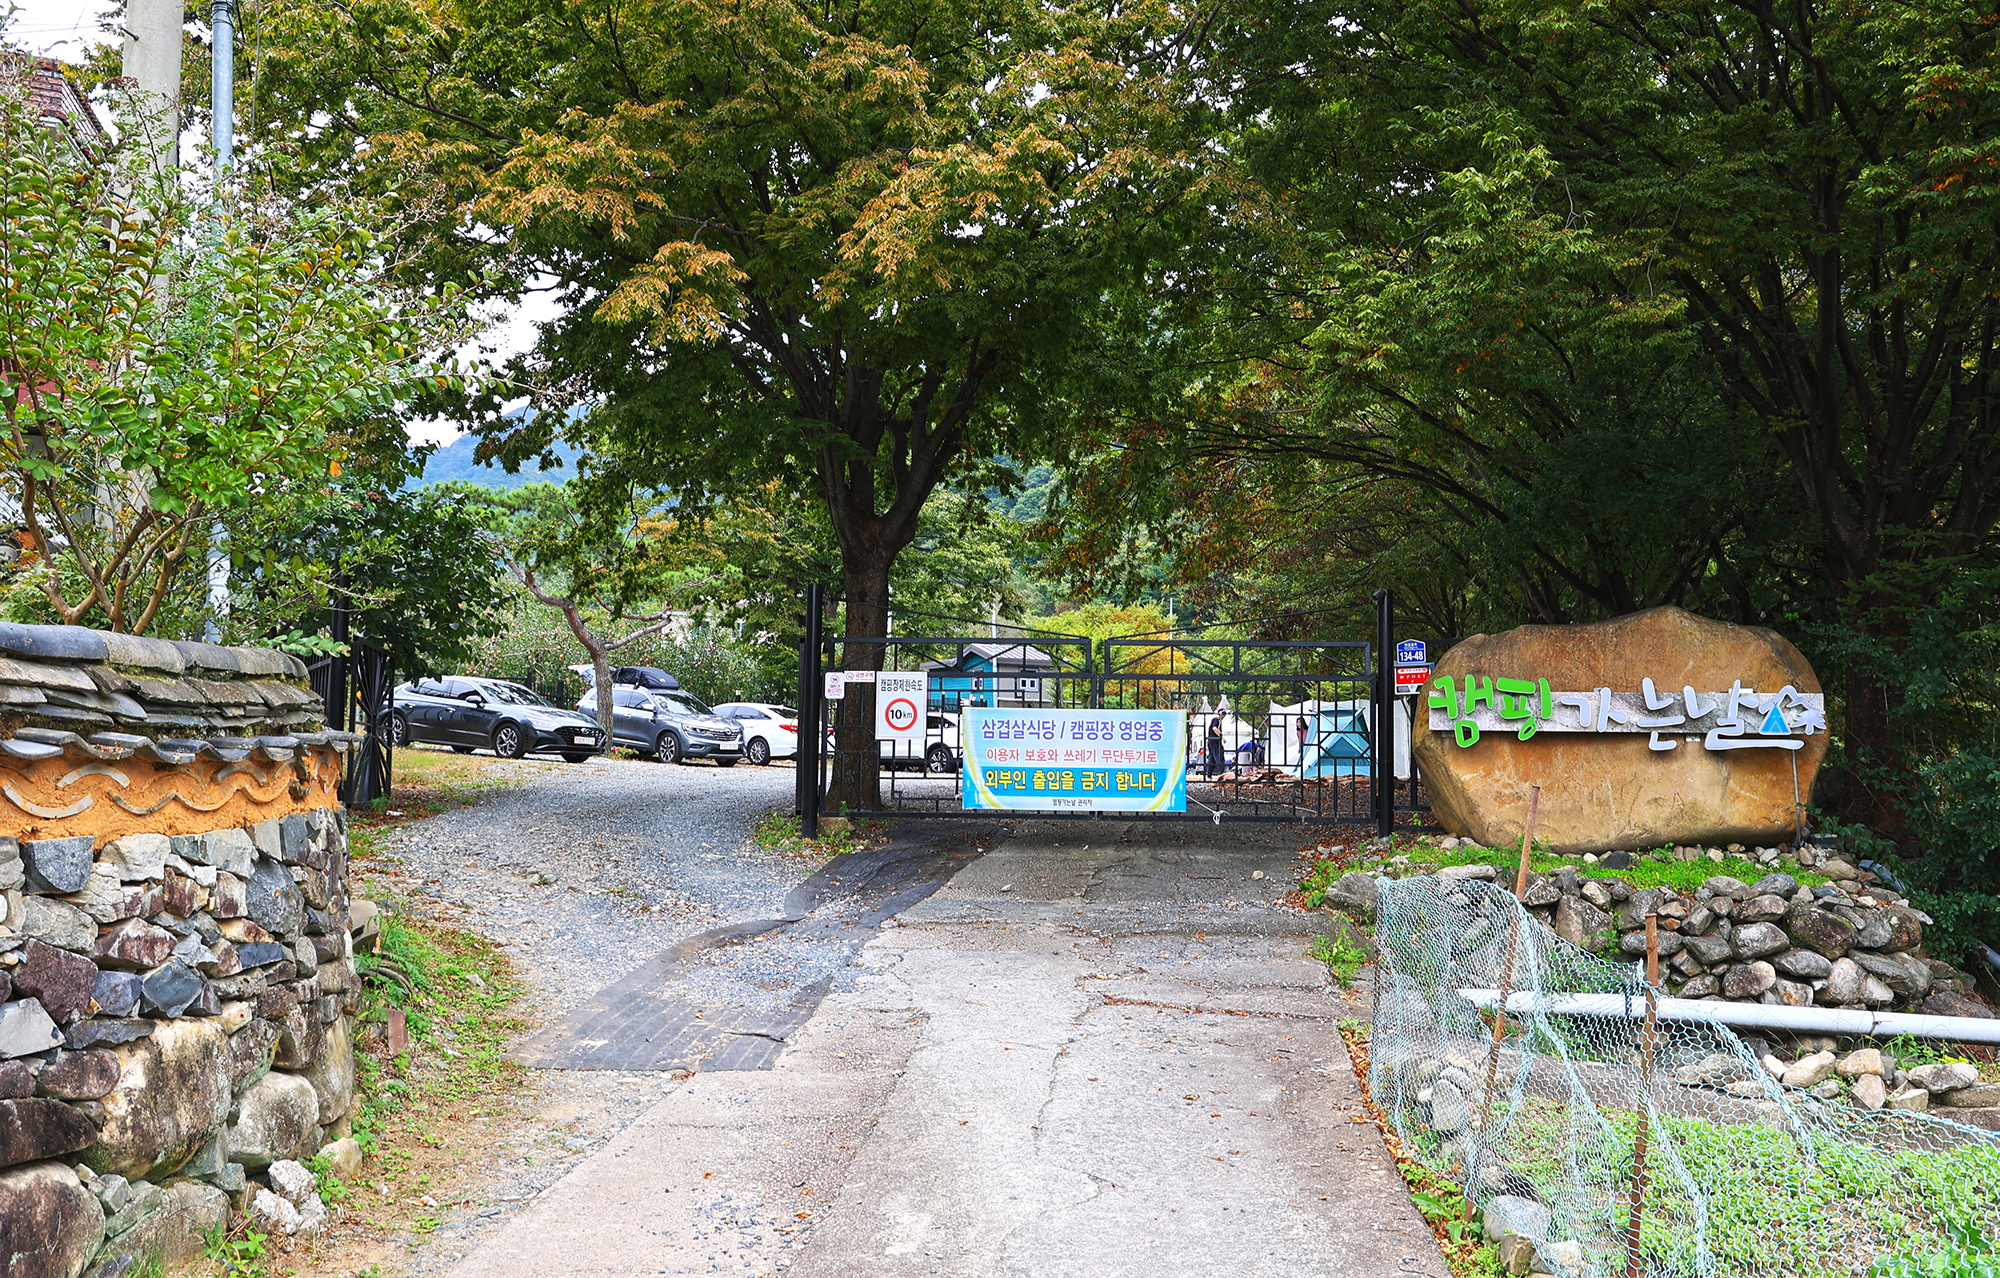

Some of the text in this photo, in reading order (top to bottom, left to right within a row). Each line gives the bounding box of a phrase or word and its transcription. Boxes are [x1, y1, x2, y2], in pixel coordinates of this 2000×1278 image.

[1400, 651, 1424, 661] 134-48
[880, 679, 923, 692] 캠핑장제한속도
[981, 719, 1056, 740] 삼겹살식당
[1070, 720, 1115, 741] 캠핑장
[1119, 721, 1163, 741] 영업중
[987, 748, 1157, 763] 이용자 보호와 쓰레기 무단투기로
[985, 769, 1156, 791] 외부인 출입을 금지 합니다
